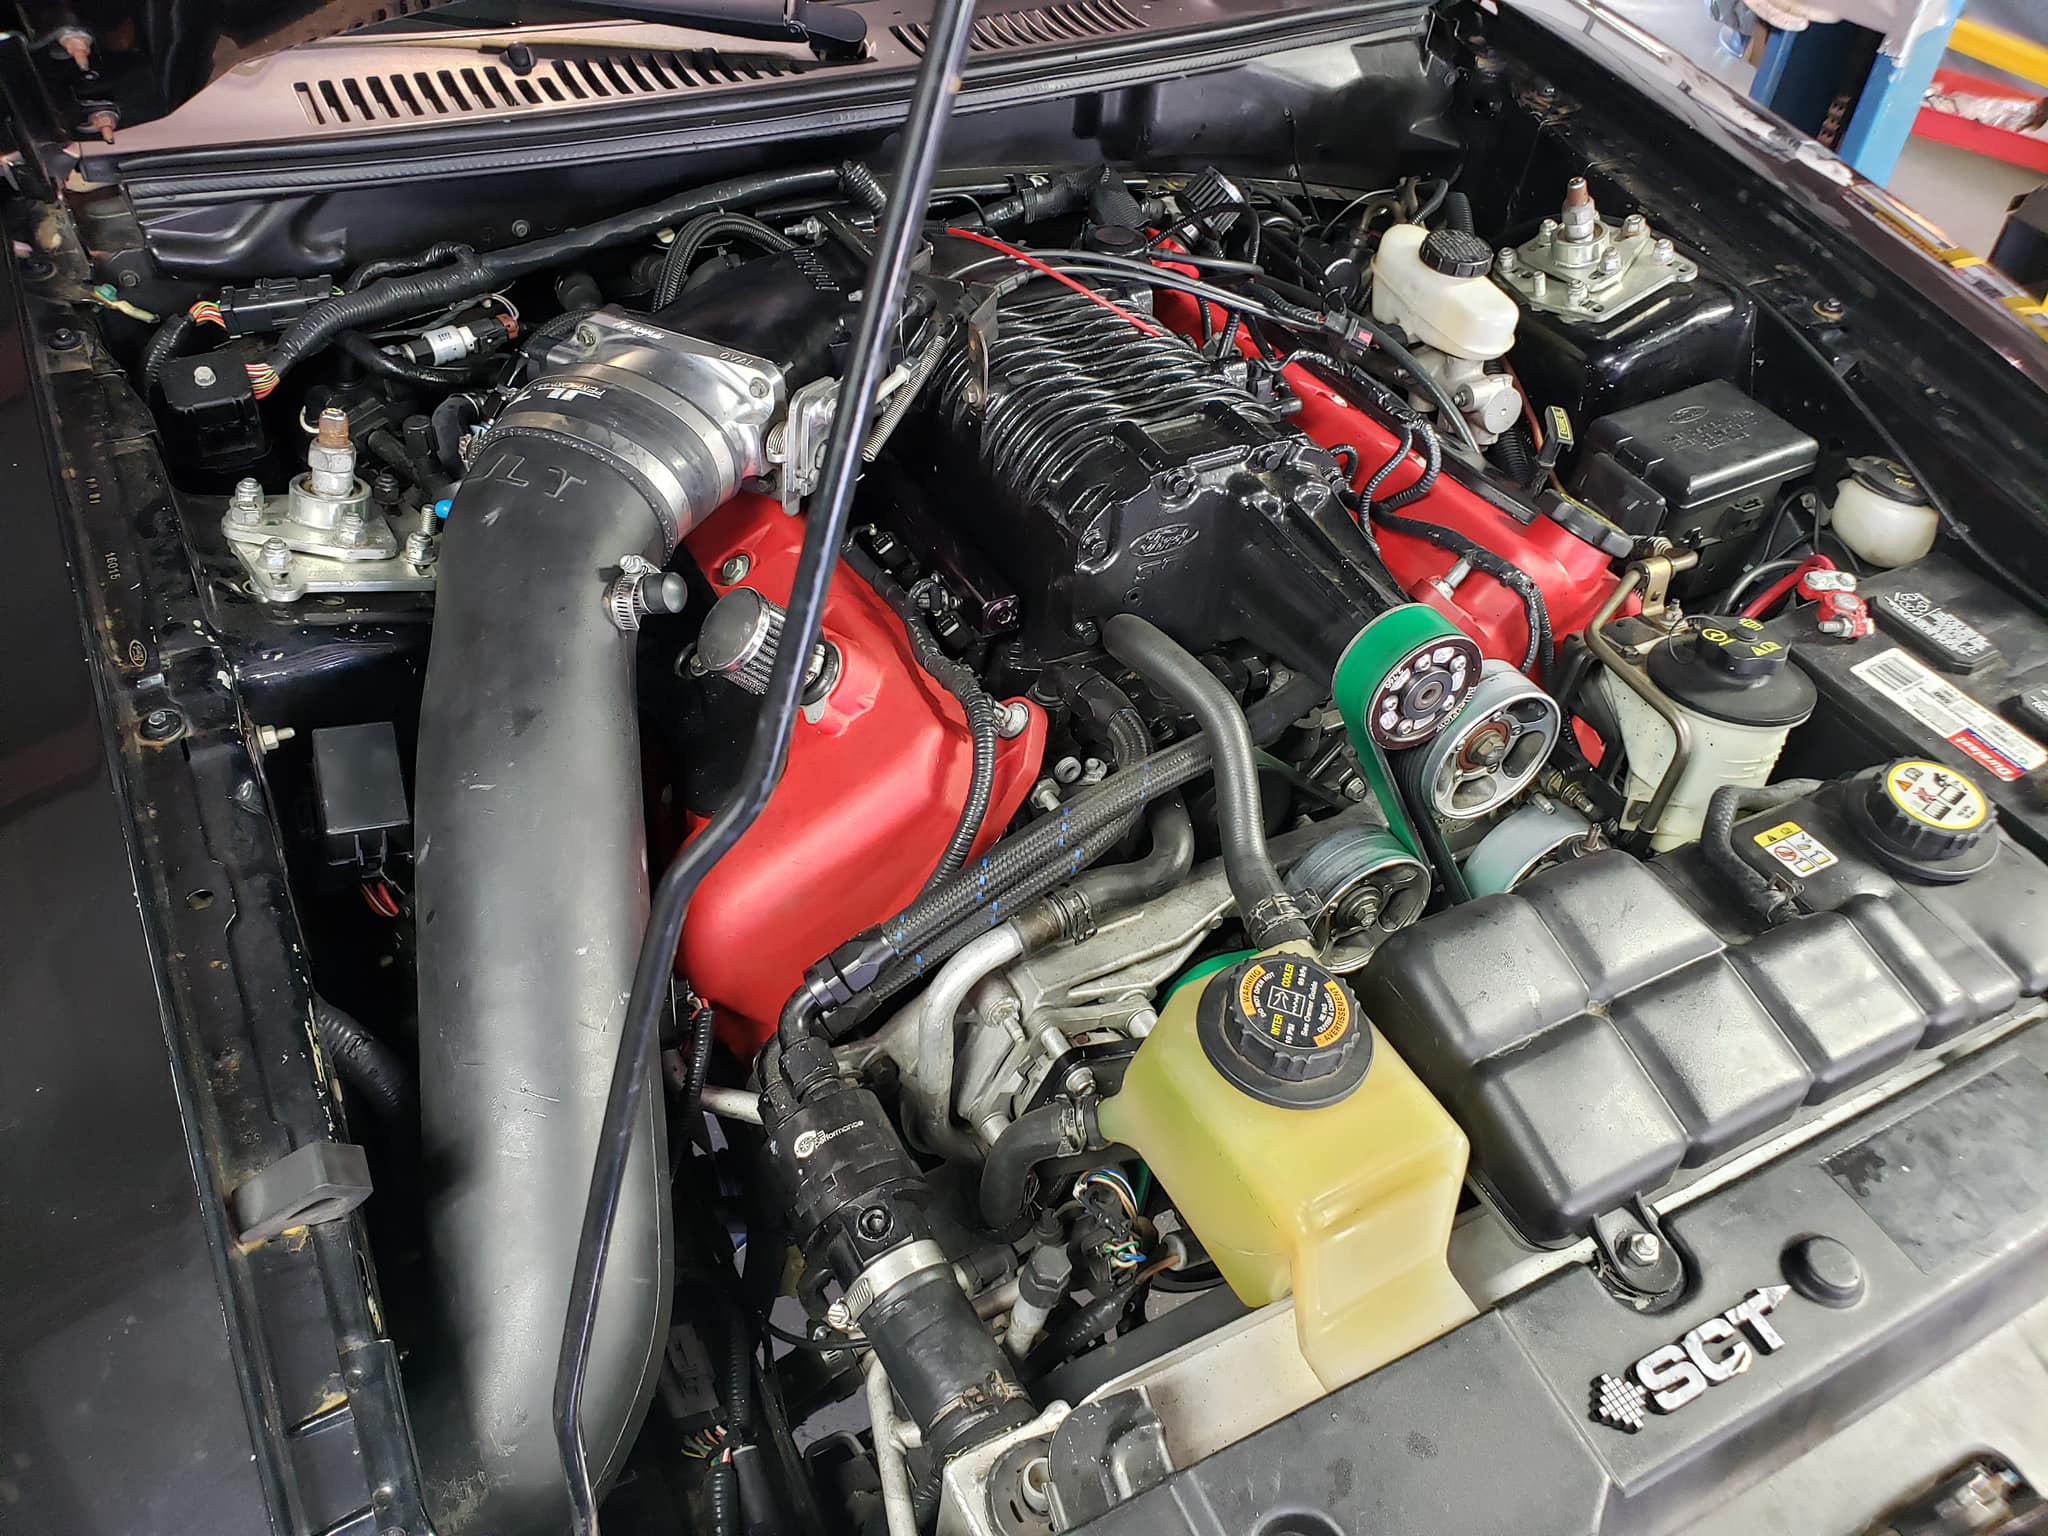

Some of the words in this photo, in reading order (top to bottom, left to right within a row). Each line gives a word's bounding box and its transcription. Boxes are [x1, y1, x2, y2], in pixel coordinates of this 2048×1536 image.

[720, 351, 754, 366] OVAL
[1956, 737, 2014, 776] Duralast
[1242, 970, 1262, 1002] WARNING
[1254, 979, 1266, 994] OPEN
[1262, 971, 1276, 982] HOT
[1270, 1014, 1284, 1036] INTER
[1281, 962, 1294, 988] COOLER
[1308, 980, 1318, 1000] Guide
[1253, 994, 1261, 1008] NOT
[1304, 1000, 1314, 1022] Owner
[1258, 1008, 1266, 1018] DO
[1324, 988, 1346, 1041] AVERTISSEMENT
[1286, 1022, 1295, 1036] PSI
[1300, 1022, 1309, 1036] See
[814, 1120, 864, 1149] performance
[1636, 1284, 1792, 1411] SCT
